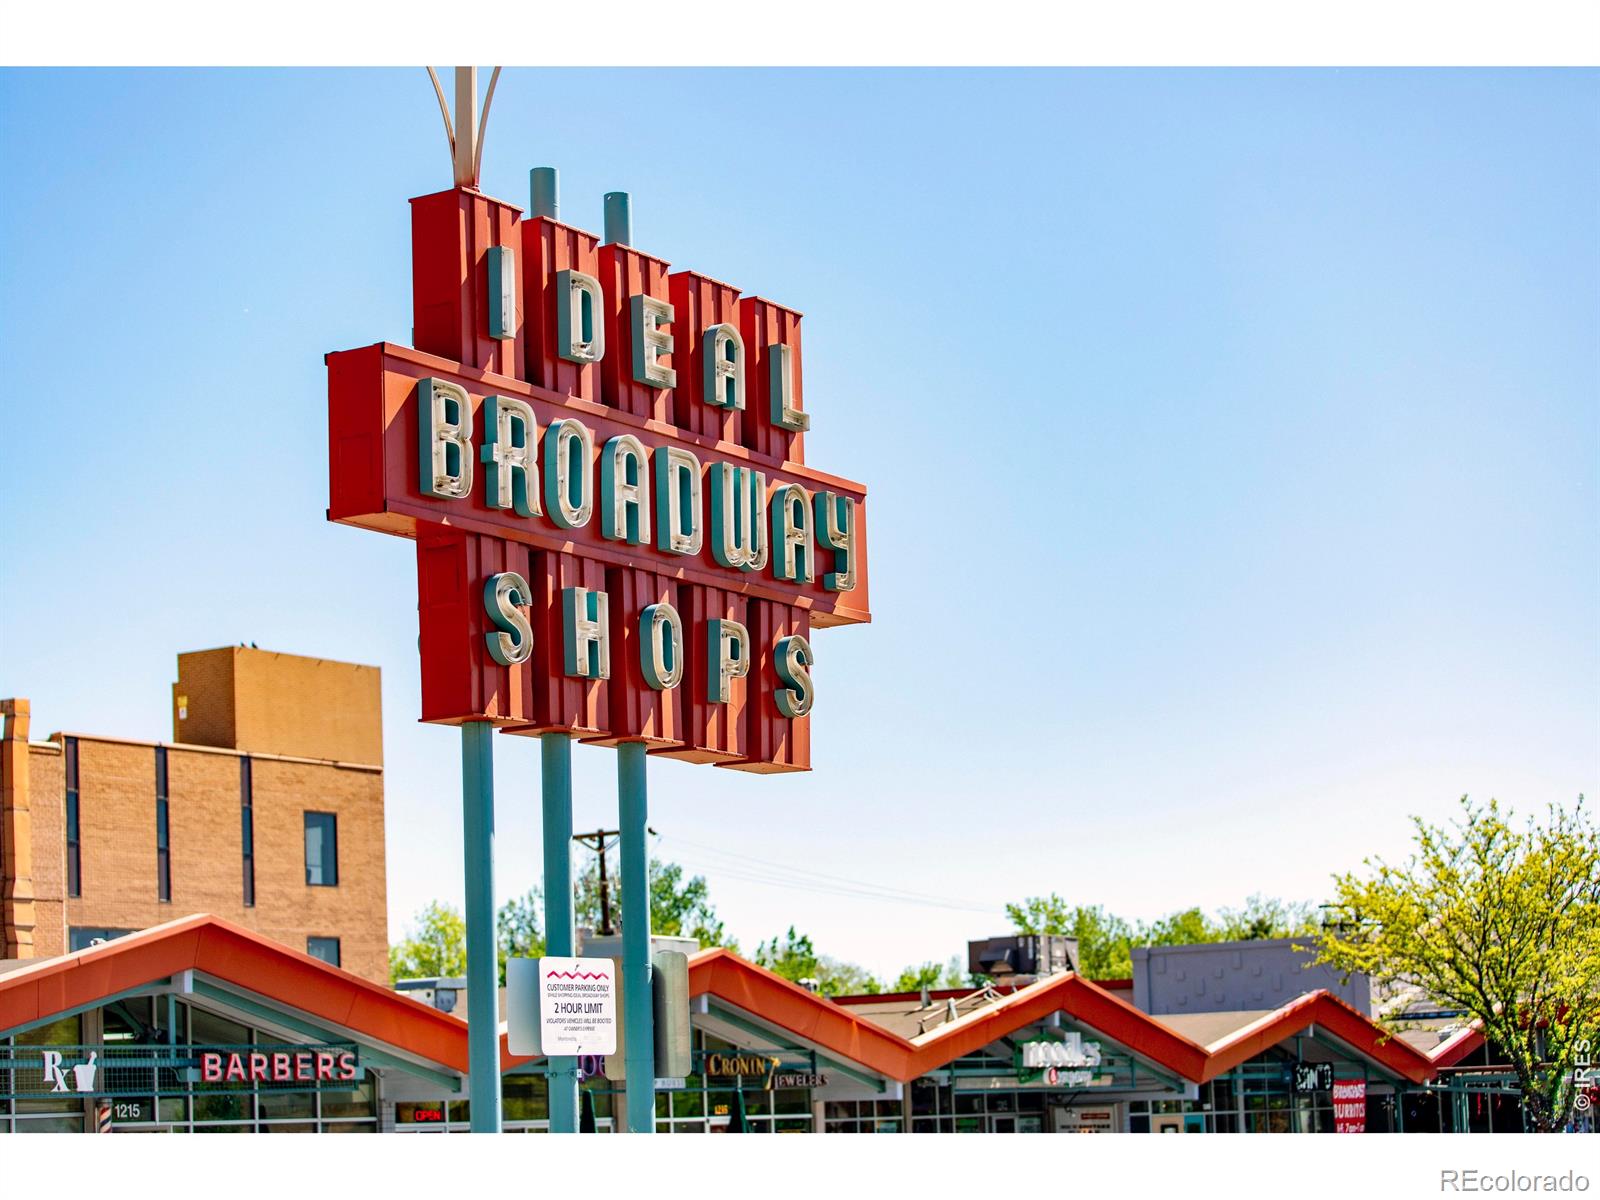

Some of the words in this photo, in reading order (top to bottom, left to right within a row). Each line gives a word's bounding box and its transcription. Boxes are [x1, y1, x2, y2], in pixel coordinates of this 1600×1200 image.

[488, 245, 809, 432] IDEAL
[418, 377, 856, 592] BROADWAY
[484, 571, 815, 718] SHOPS
[547, 984, 574, 992] CUSTOMER
[575, 984, 596, 992] PARKING
[597, 985, 609, 993] ONLY
[554, 1003, 559, 1013] 2
[561, 1003, 582, 1013] HOUR
[584, 1003, 603, 1013] LIMIT
[201, 1052, 356, 1081] BARBERS
[709, 1054, 766, 1075] CRONIN
[774, 1074, 829, 1088] JEWELERS
[114, 1104, 140, 1118] 1215
[415, 1110, 441, 1121] OPEN
